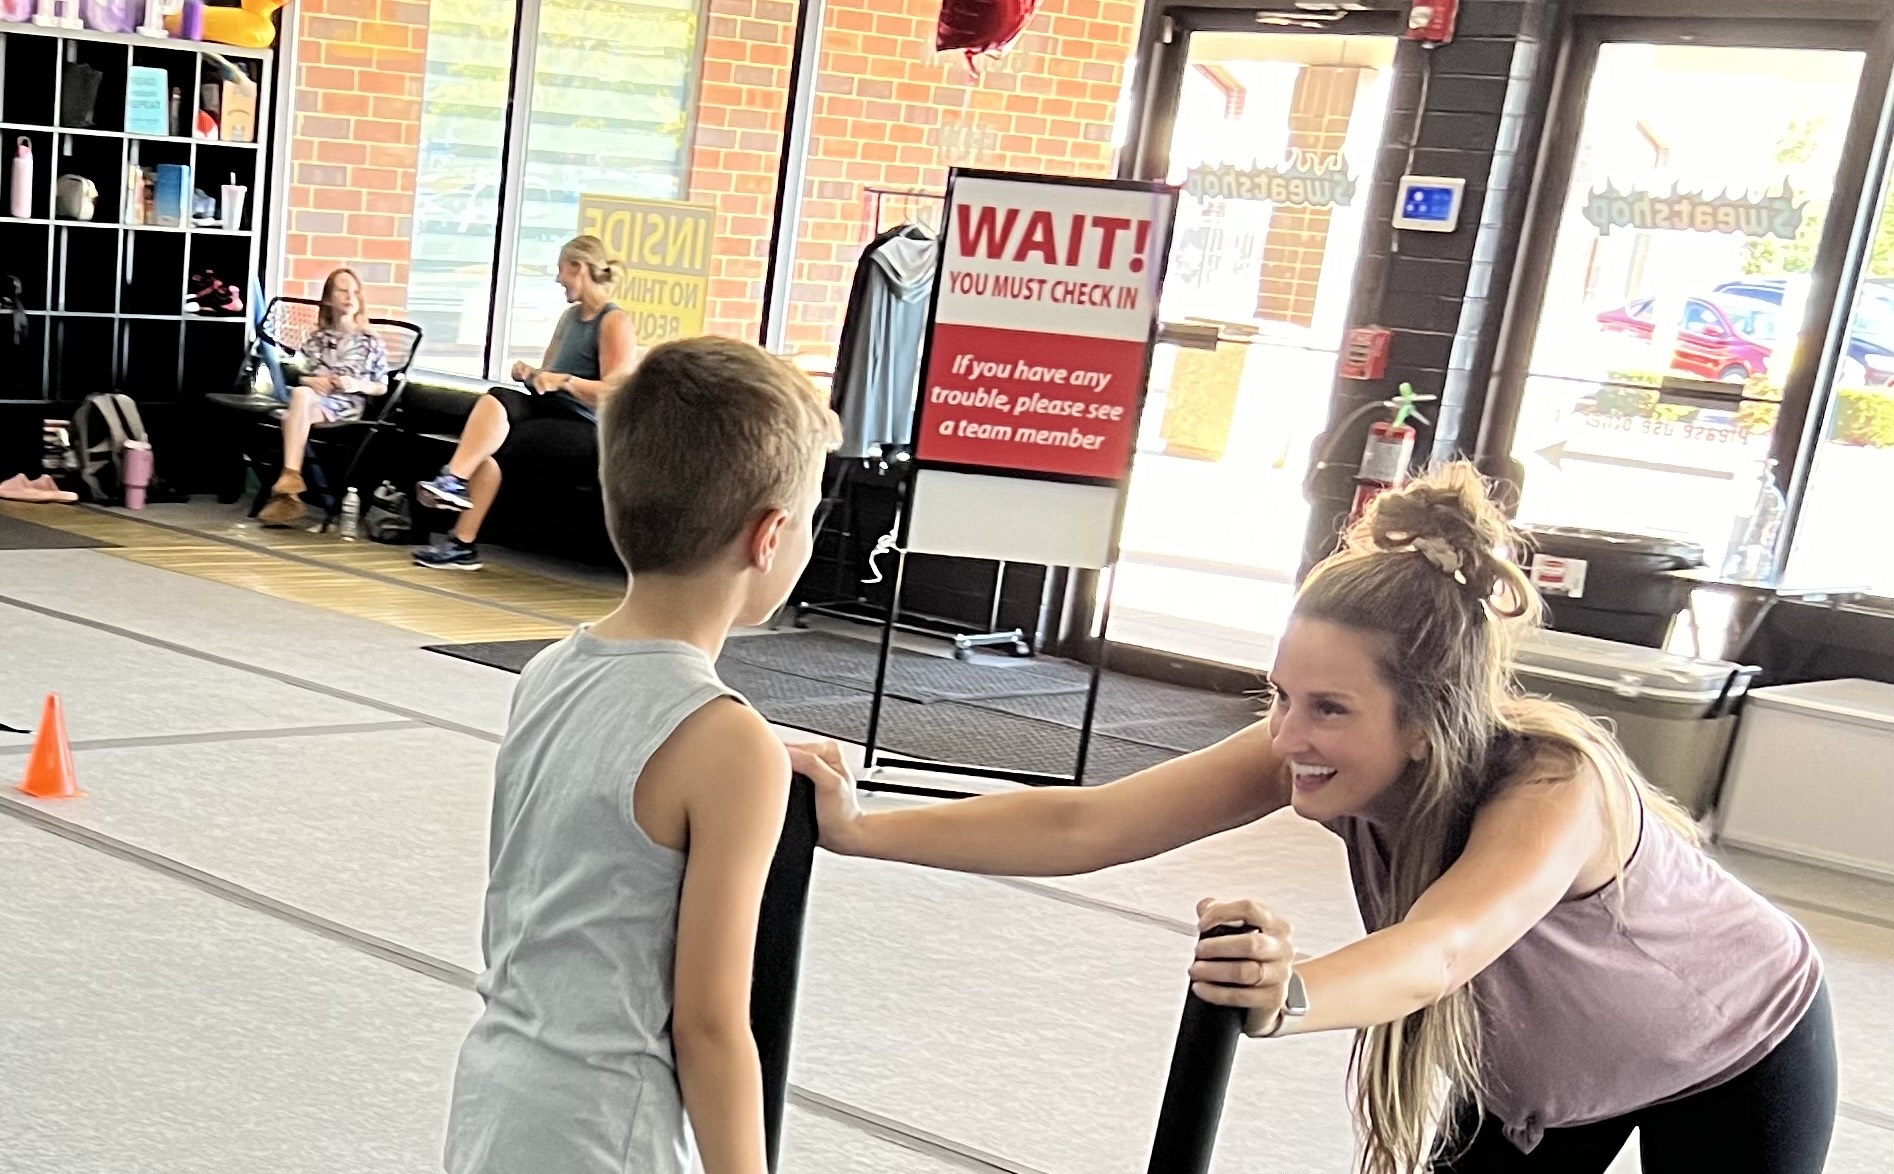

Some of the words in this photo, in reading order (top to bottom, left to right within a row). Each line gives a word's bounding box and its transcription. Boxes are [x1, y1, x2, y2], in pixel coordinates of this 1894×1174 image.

[957, 203, 1152, 273] WAIT!
[950, 270, 989, 296] YOU
[991, 274, 1047, 301] MUST
[1050, 280, 1114, 308] CHECK
[1116, 285, 1139, 310] IN
[951, 354, 974, 375] If
[967, 360, 1012, 381] you
[1013, 359, 1068, 384] have
[1069, 369, 1113, 393] any
[930, 385, 1012, 413] trouble,
[1013, 392, 1087, 416] please
[1085, 404, 1125, 421] see
[938, 419, 956, 435] a
[957, 419, 1013, 441] team
[1013, 427, 1106, 450] member
